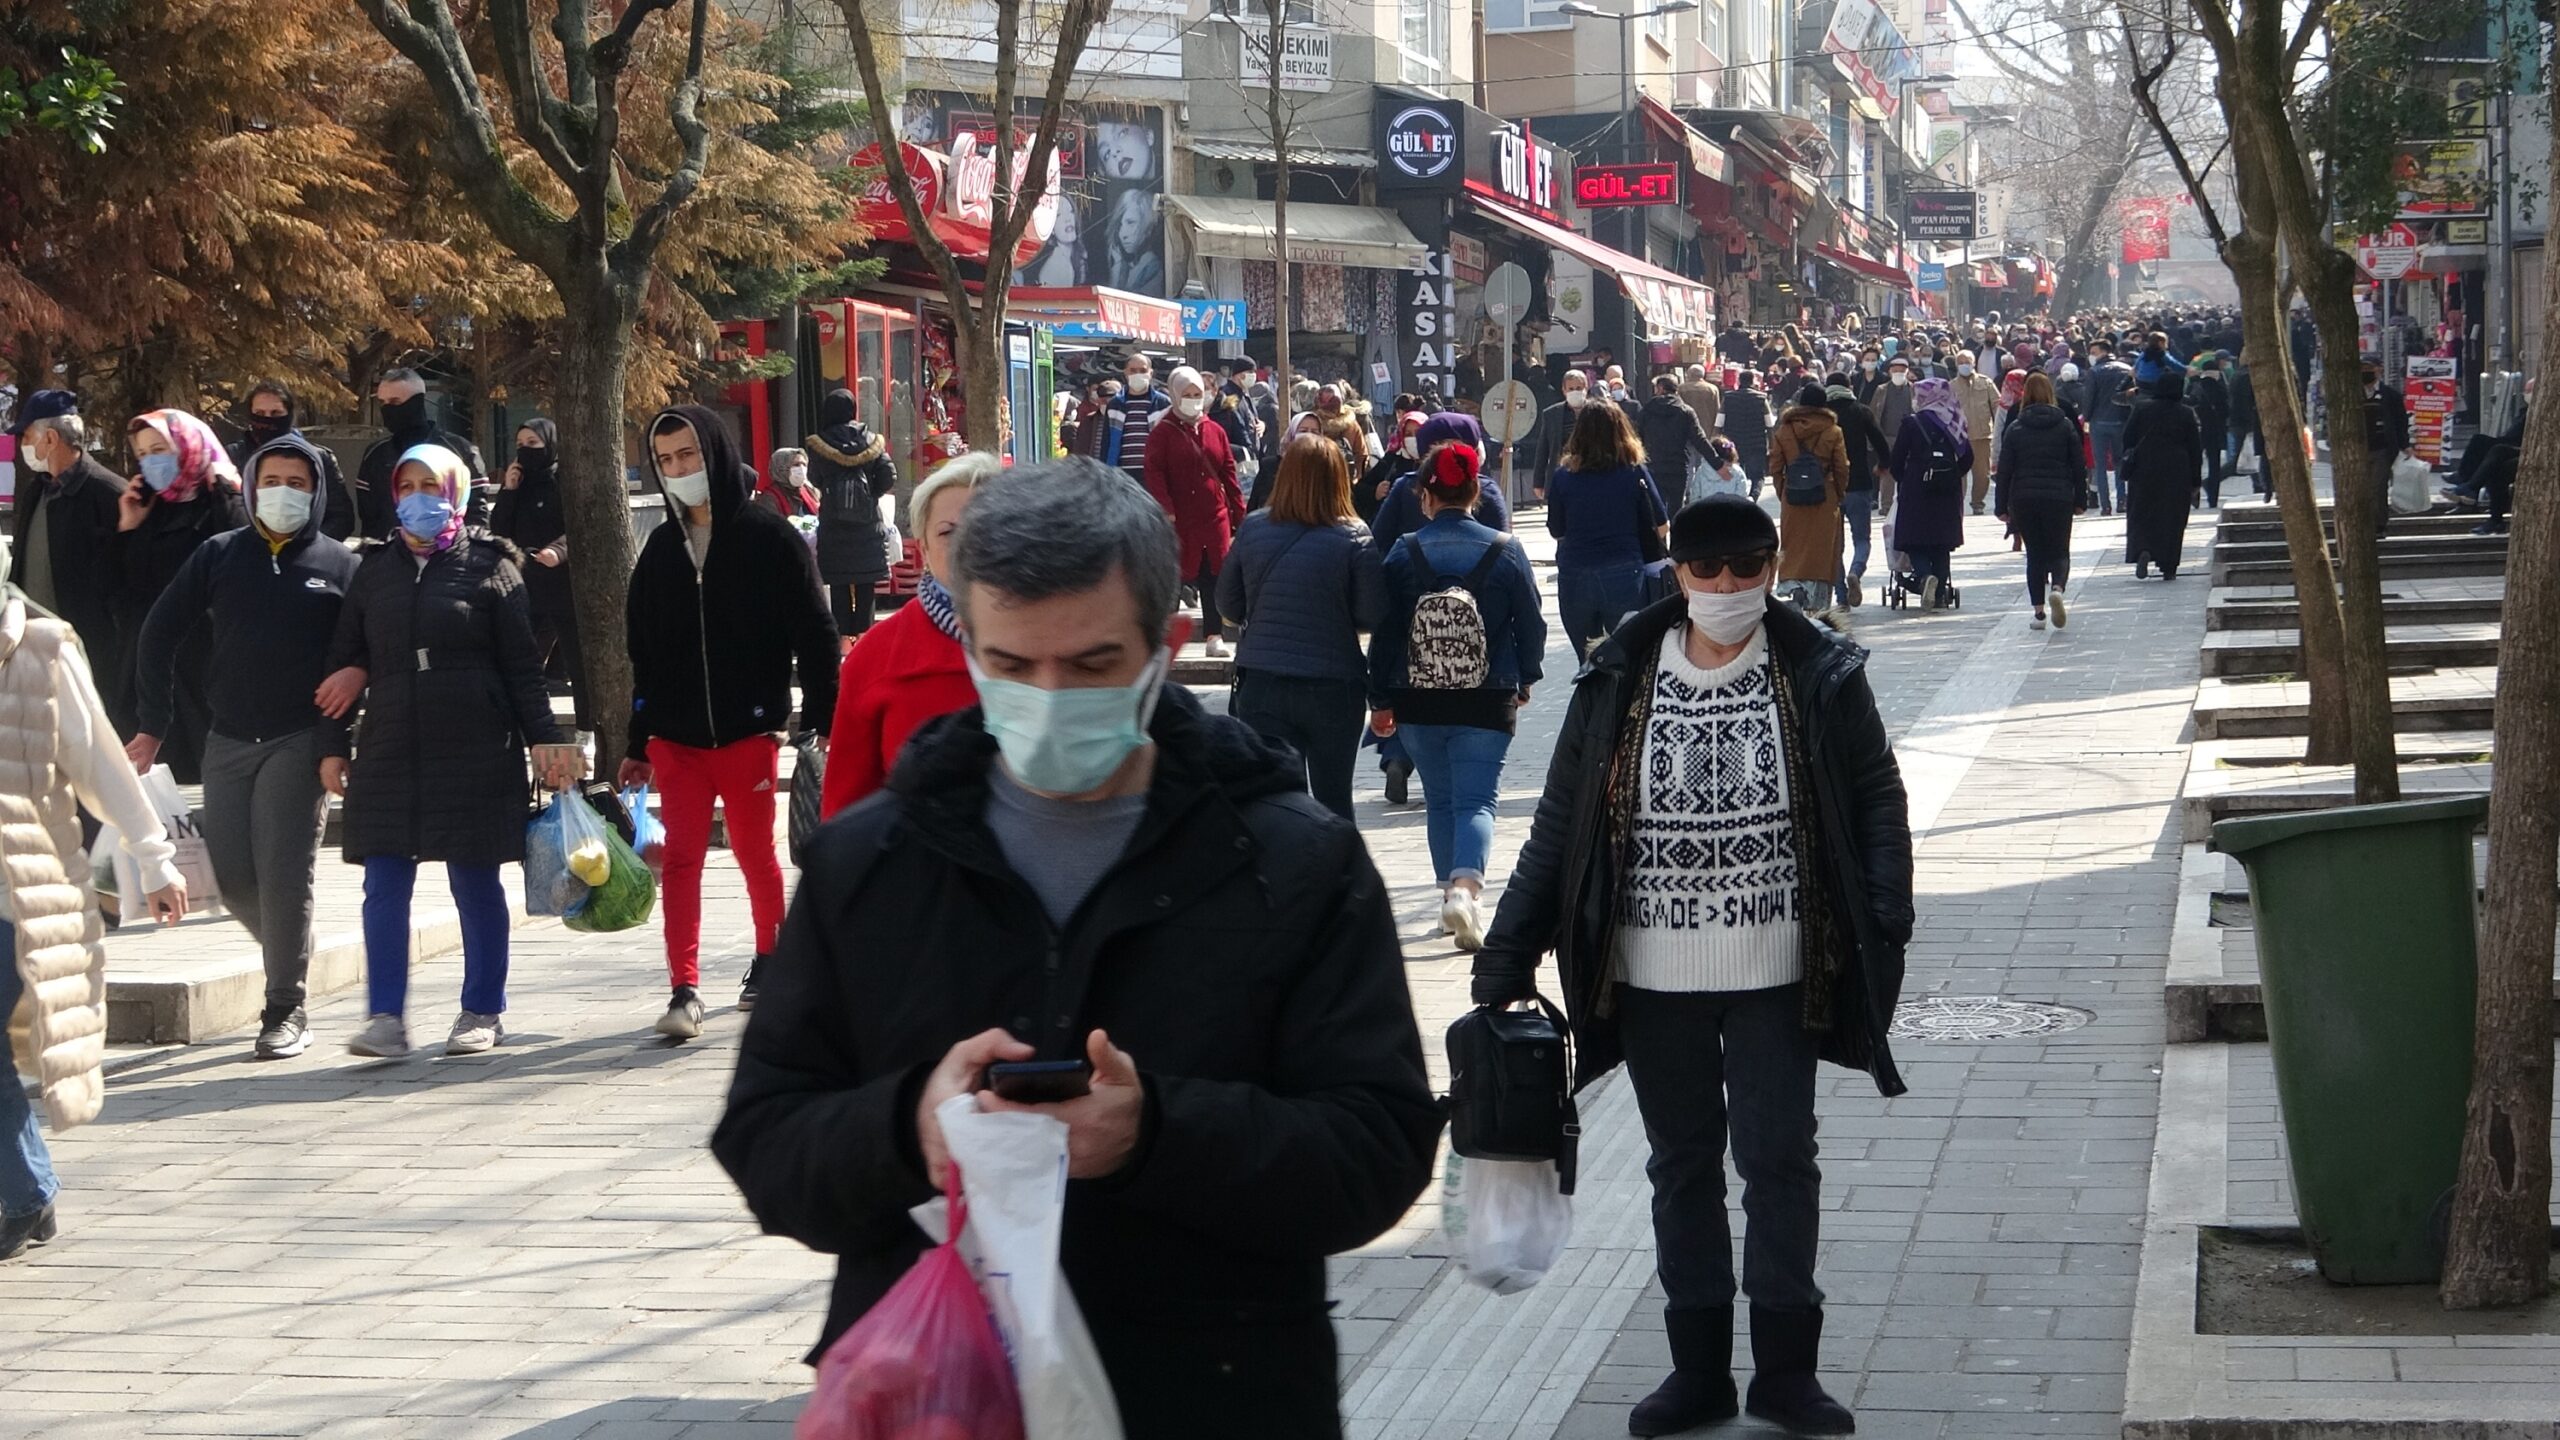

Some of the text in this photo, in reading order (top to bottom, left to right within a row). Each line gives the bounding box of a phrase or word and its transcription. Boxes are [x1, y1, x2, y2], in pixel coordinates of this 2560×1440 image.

[1390, 131, 1453, 152] GÜL ET
[1500, 122, 1552, 209] GÜL ET
[1580, 173, 1672, 199] GÜL-ET
[1911, 215, 1938, 224] TOPTAN
[1978, 193, 1988, 235] beko
[1920, 226, 1961, 234] PERAKENDE
[1921, 272, 1942, 280] beko
[1218, 304, 1236, 336] 75
[1723, 889, 1785, 928] SNOW
